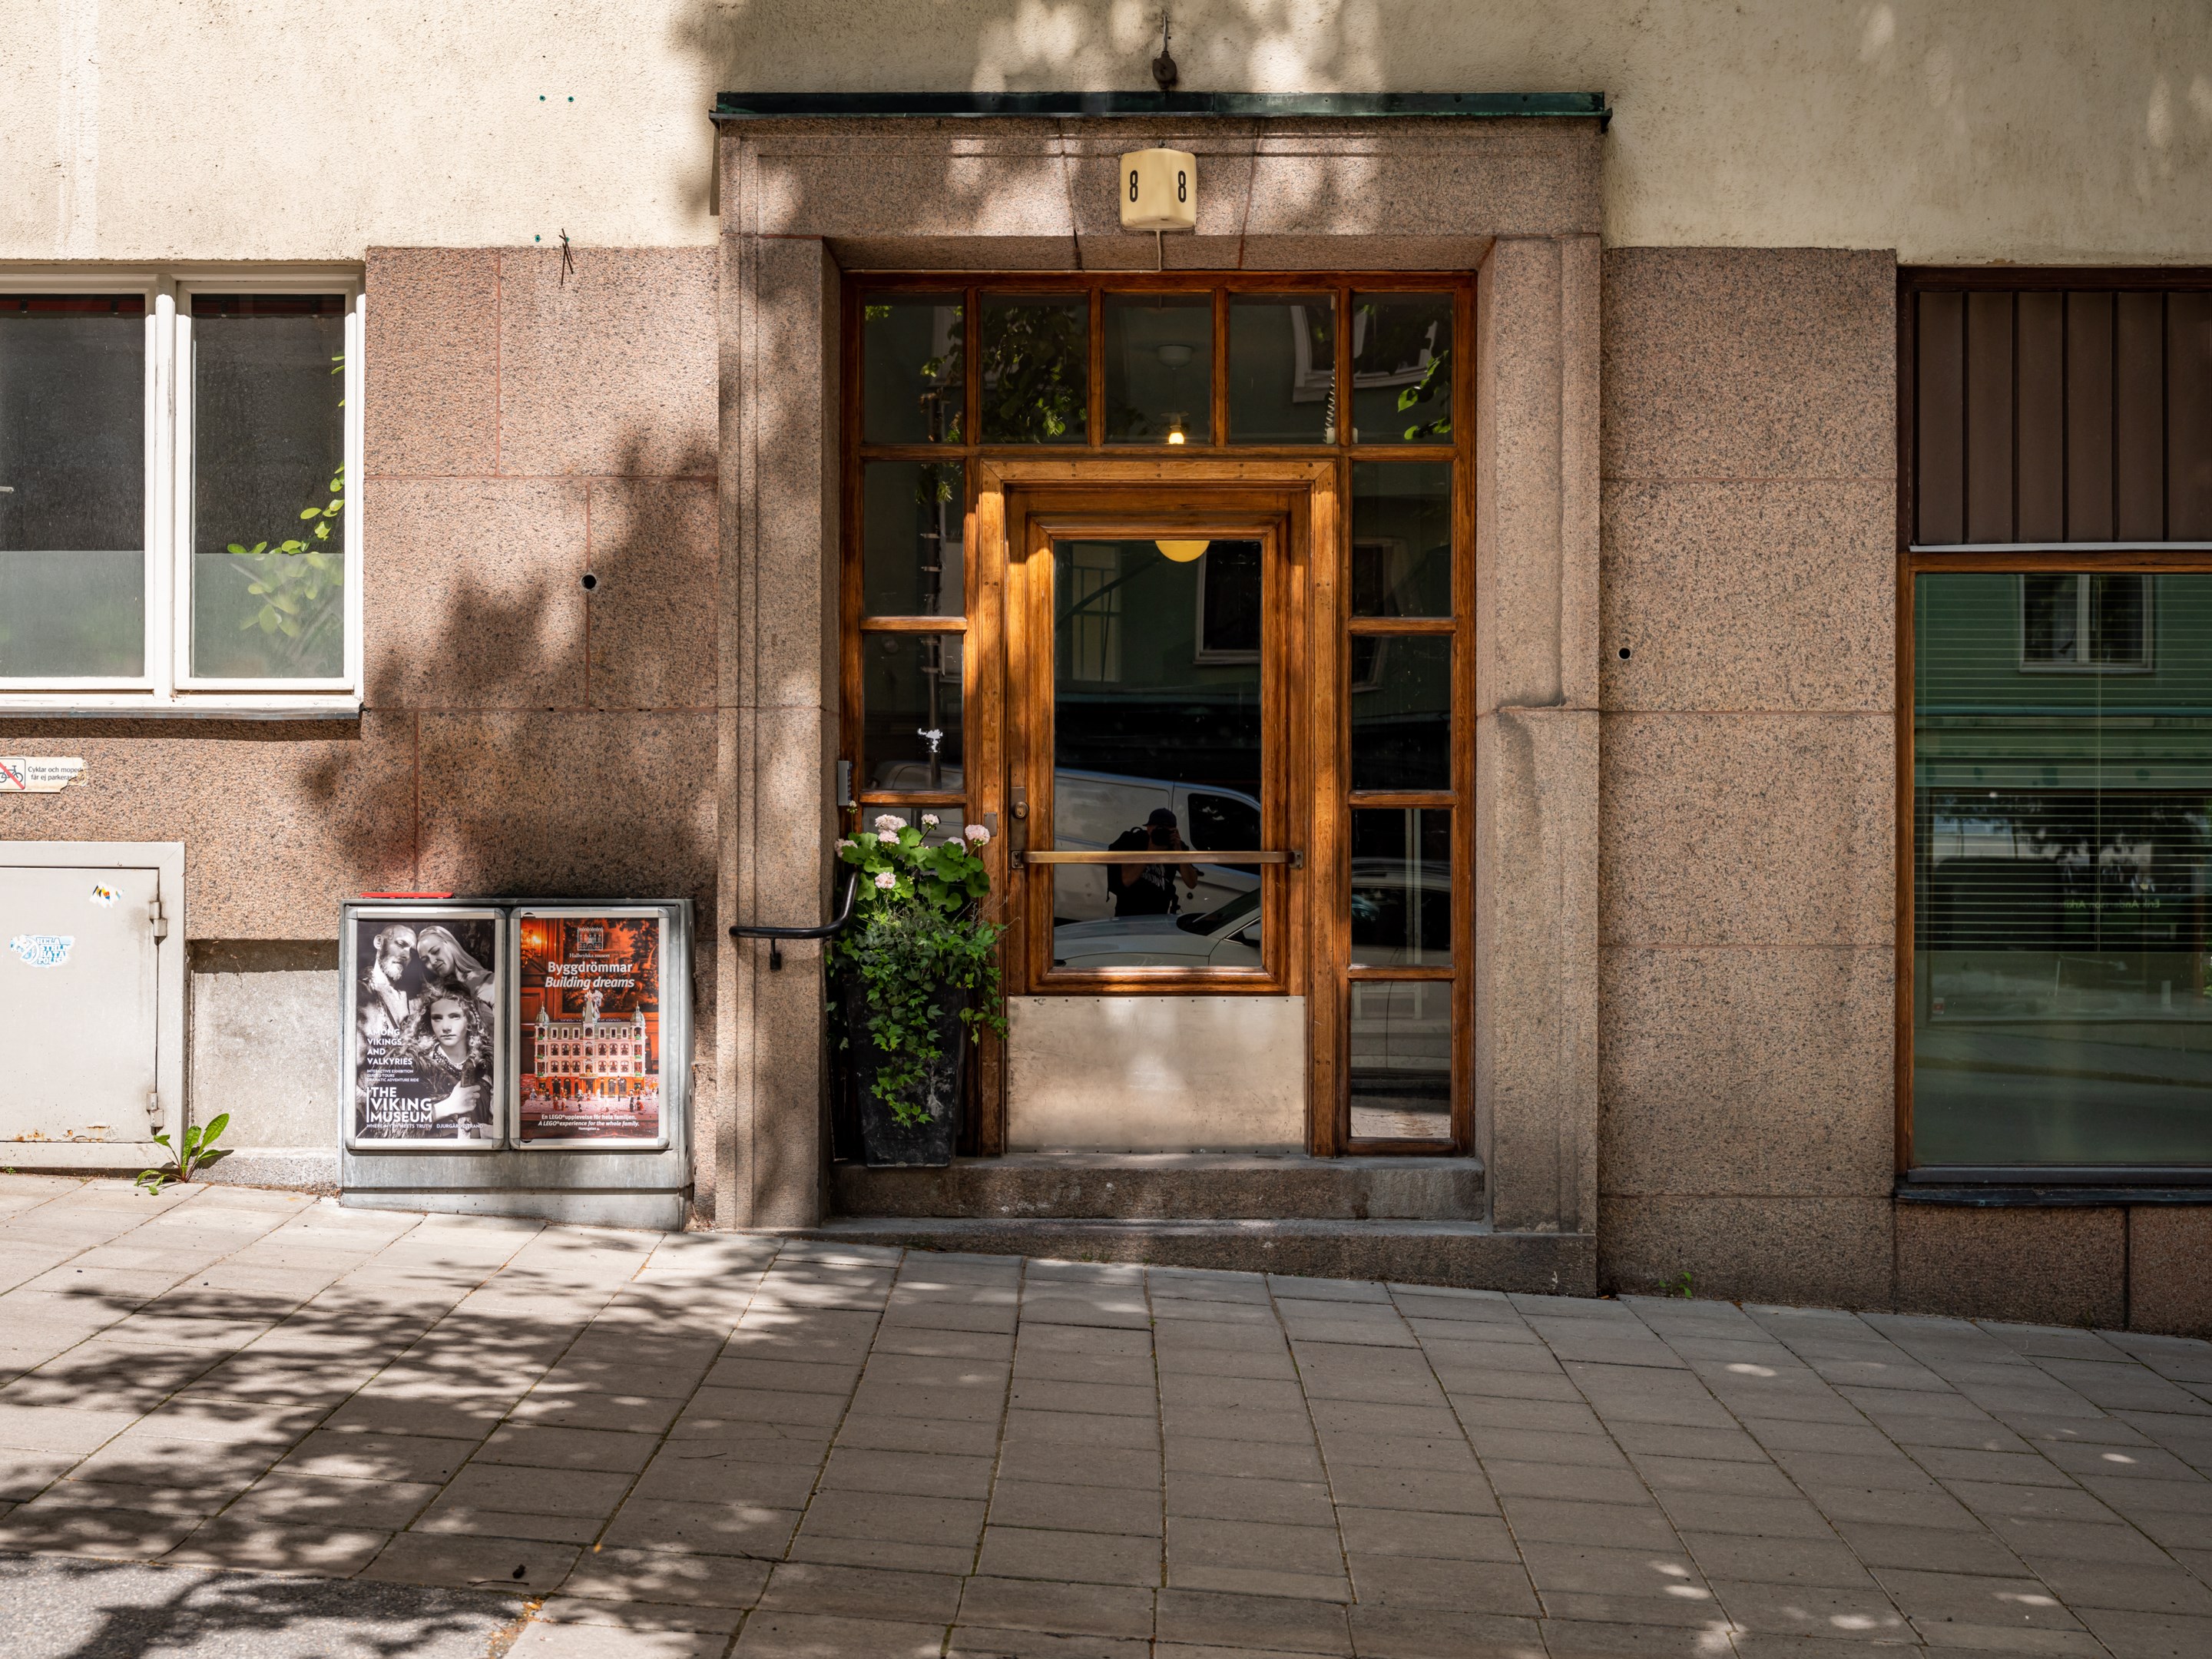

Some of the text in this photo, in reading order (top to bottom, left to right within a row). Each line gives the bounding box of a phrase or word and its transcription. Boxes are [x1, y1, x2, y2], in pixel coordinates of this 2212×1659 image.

[1130, 170, 1138, 203] 8
[1177, 170, 1187, 203] 8
[548, 962, 633, 975] Byggdrömmar
[545, 976, 635, 991] Building dreams
[371, 1087, 397, 1098] THE
[370, 1098, 432, 1111] VIKING
[370, 1111, 432, 1122] MUSEUM
